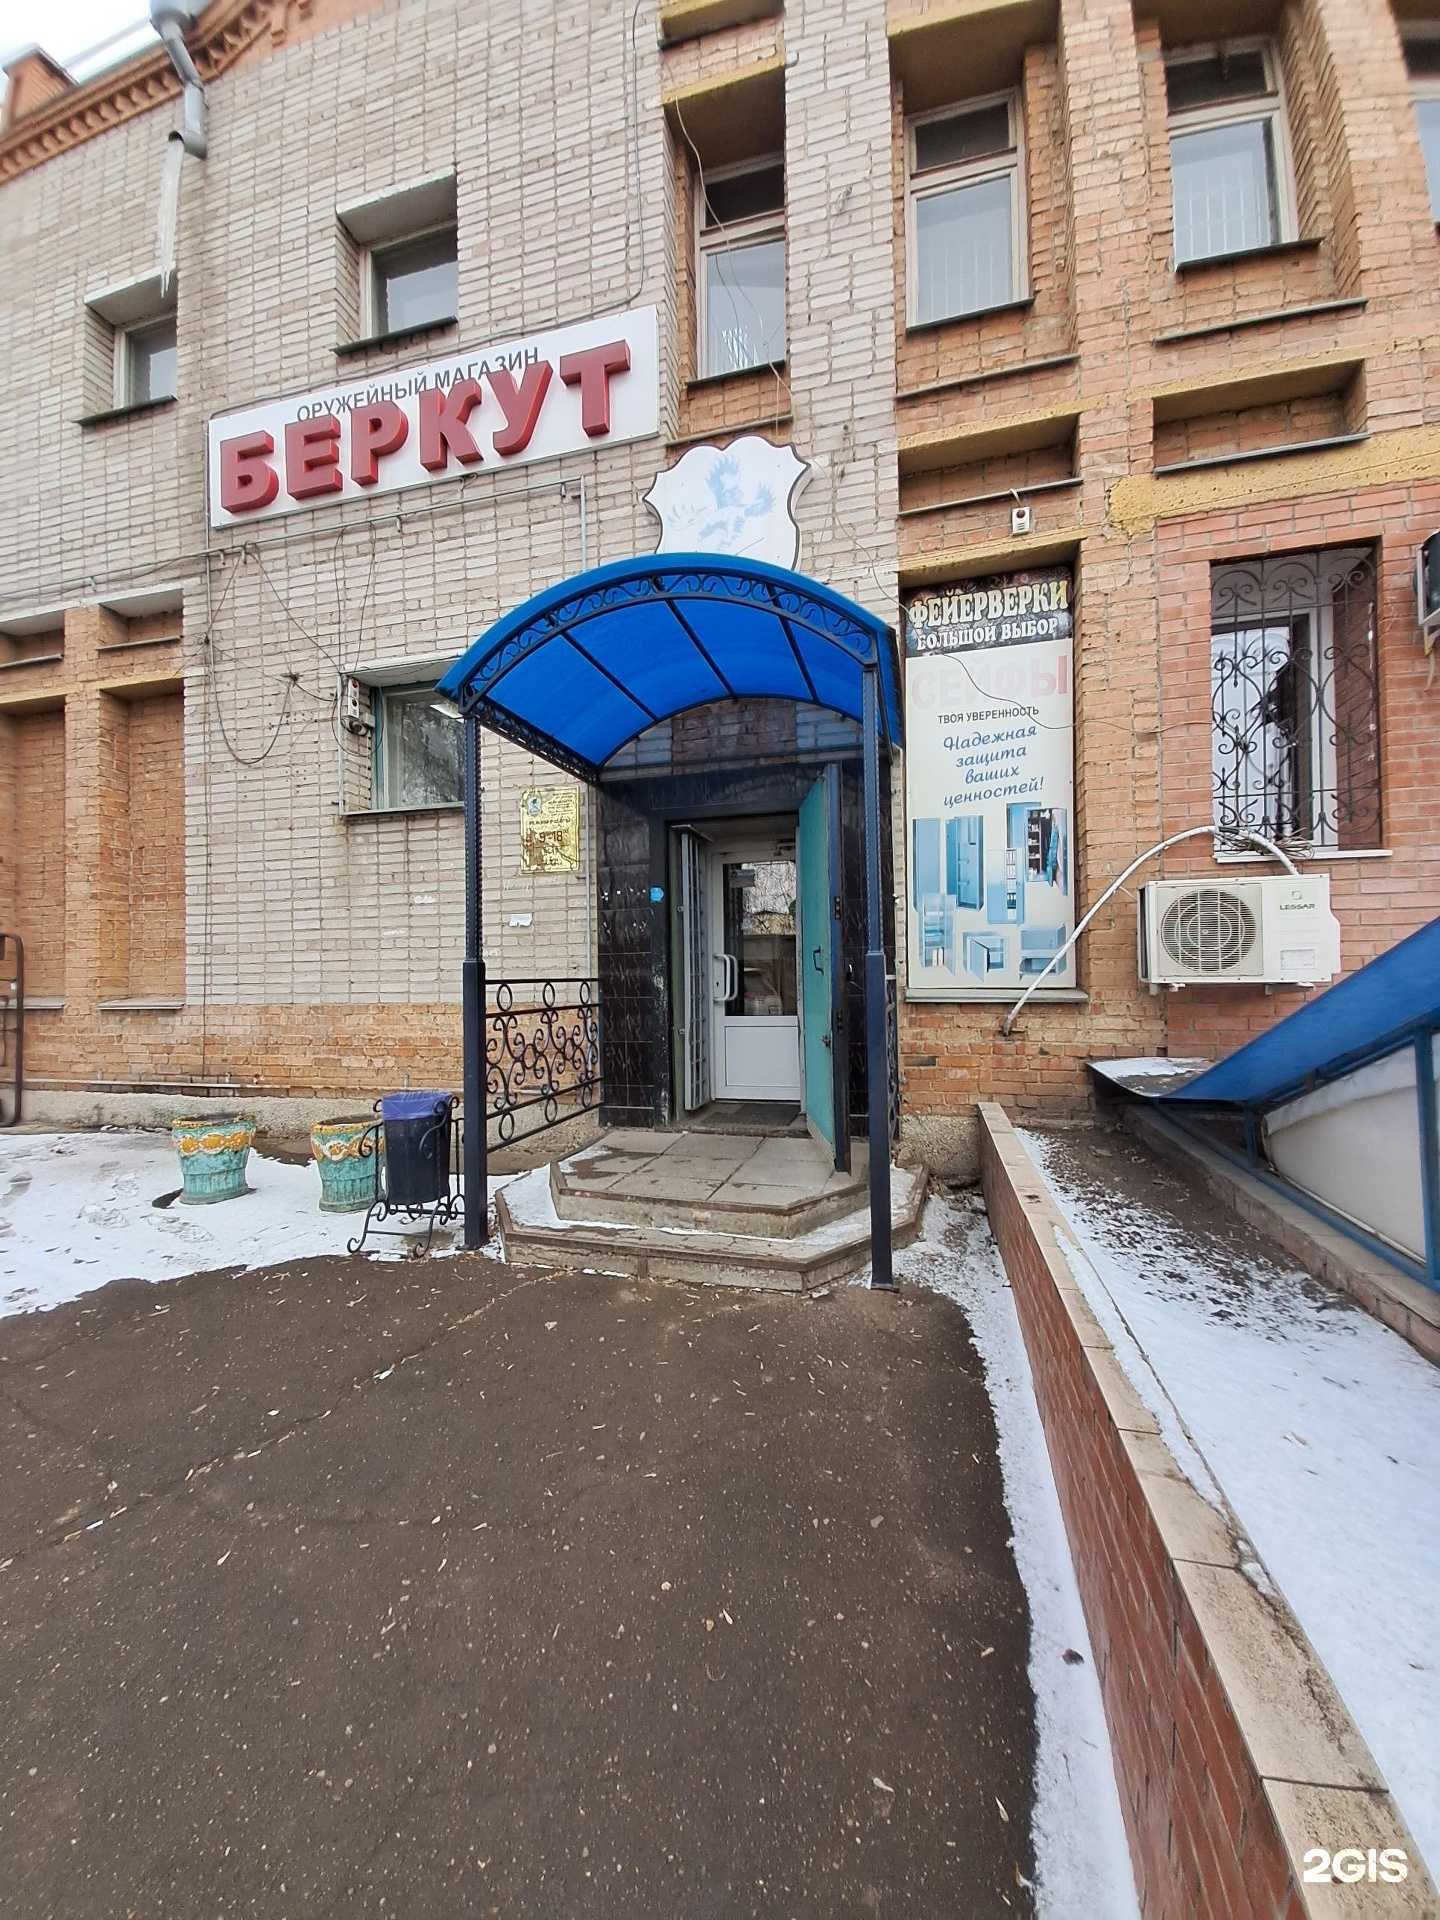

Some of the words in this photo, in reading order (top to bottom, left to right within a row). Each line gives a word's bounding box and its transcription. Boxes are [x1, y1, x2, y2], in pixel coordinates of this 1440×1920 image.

[296, 371, 428, 423] ОРУЖЕЙНЫЙ
[433, 346, 540, 392] МАГАЗИН
[219, 339, 632, 513] БЕРКУТ
[908, 580, 1069, 629] ФЕЙЕРВЕРКИ
[916, 620, 998, 651] БОЛЬШОЙ
[1001, 617, 1059, 641] ВЫБОР
[938, 712, 964, 725] ТВОЯ
[966, 706, 1040, 723] УВЕРЕННОСТЬ
[943, 725, 1038, 752] Надежная
[955, 744, 1027, 769] защита
[965, 765, 1020, 785] ваших
[943, 776, 1044, 809] ценностей!
